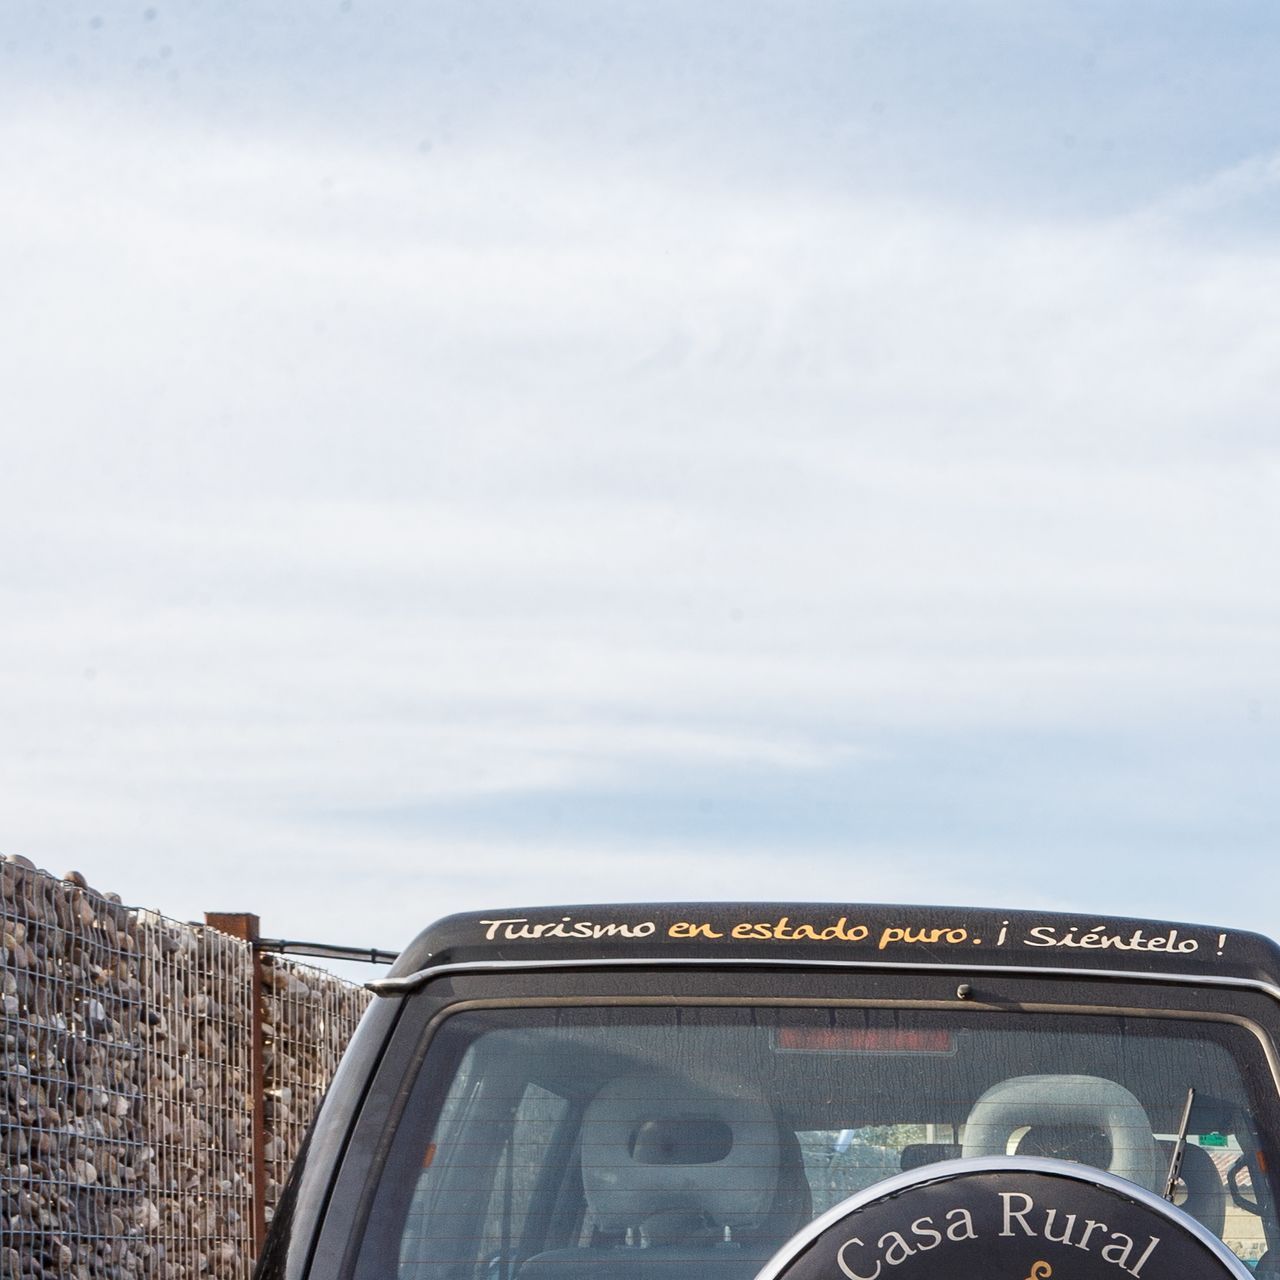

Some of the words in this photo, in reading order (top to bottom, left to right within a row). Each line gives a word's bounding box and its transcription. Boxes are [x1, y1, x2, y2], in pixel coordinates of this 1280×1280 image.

[478, 916, 656, 940] Turismo
[668, 922, 723, 938] en
[731, 917, 869, 941] estado
[879, 927, 982, 950] puro.
[1023, 925, 1200, 954] Siéntelo
[998, 1191, 1161, 1279] Rural
